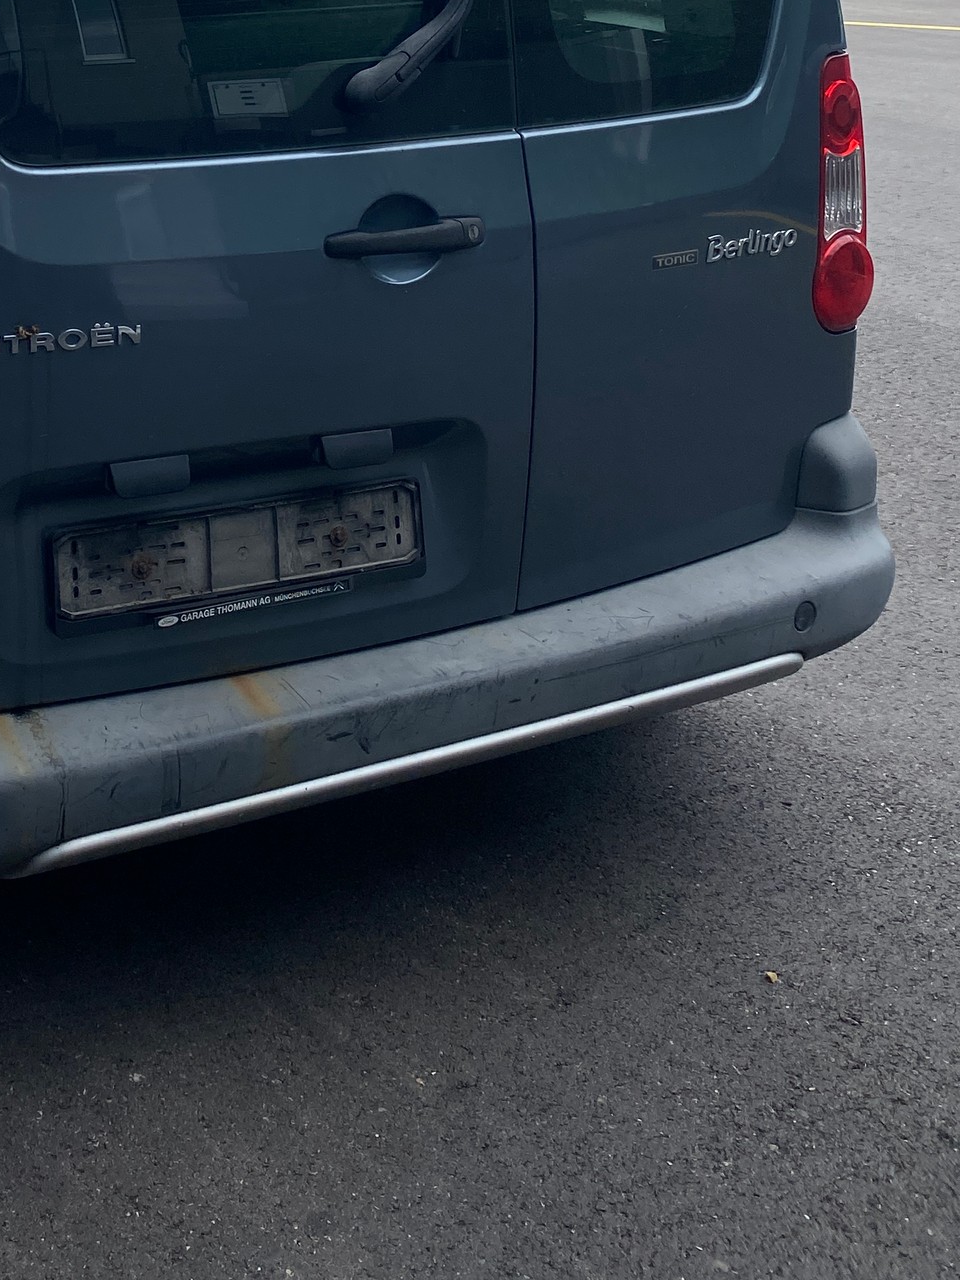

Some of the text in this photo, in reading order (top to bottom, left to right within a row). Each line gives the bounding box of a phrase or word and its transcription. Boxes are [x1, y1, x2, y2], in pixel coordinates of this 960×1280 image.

[656, 228, 798, 268] TONIC Berlingo
[181, 607, 215, 622] GARAGE
[217, 599, 258, 615] THOMANN
[259, 596, 271, 607] AG
